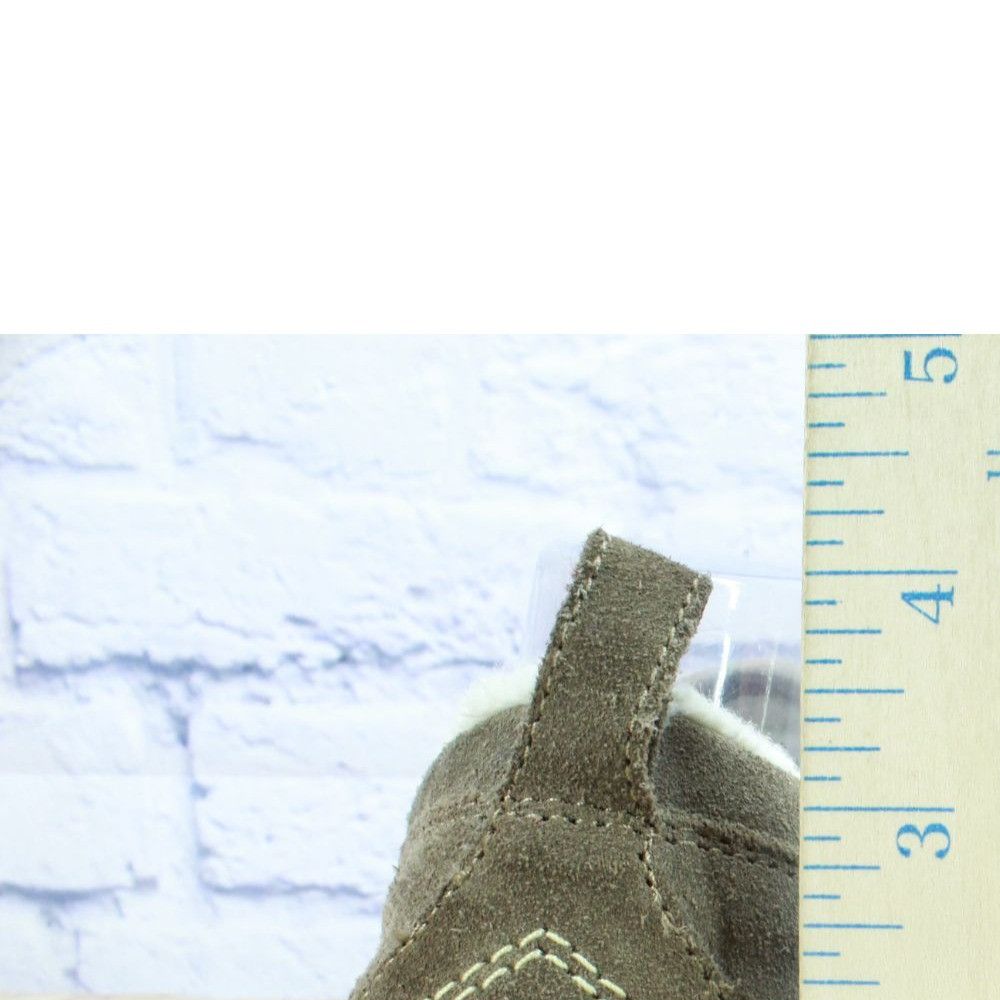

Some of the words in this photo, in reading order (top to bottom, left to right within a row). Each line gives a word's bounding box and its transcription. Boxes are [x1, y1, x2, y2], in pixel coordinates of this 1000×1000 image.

[903, 347, 958, 384] 5
[901, 584, 955, 624] 4
[896, 822, 951, 860] 3
